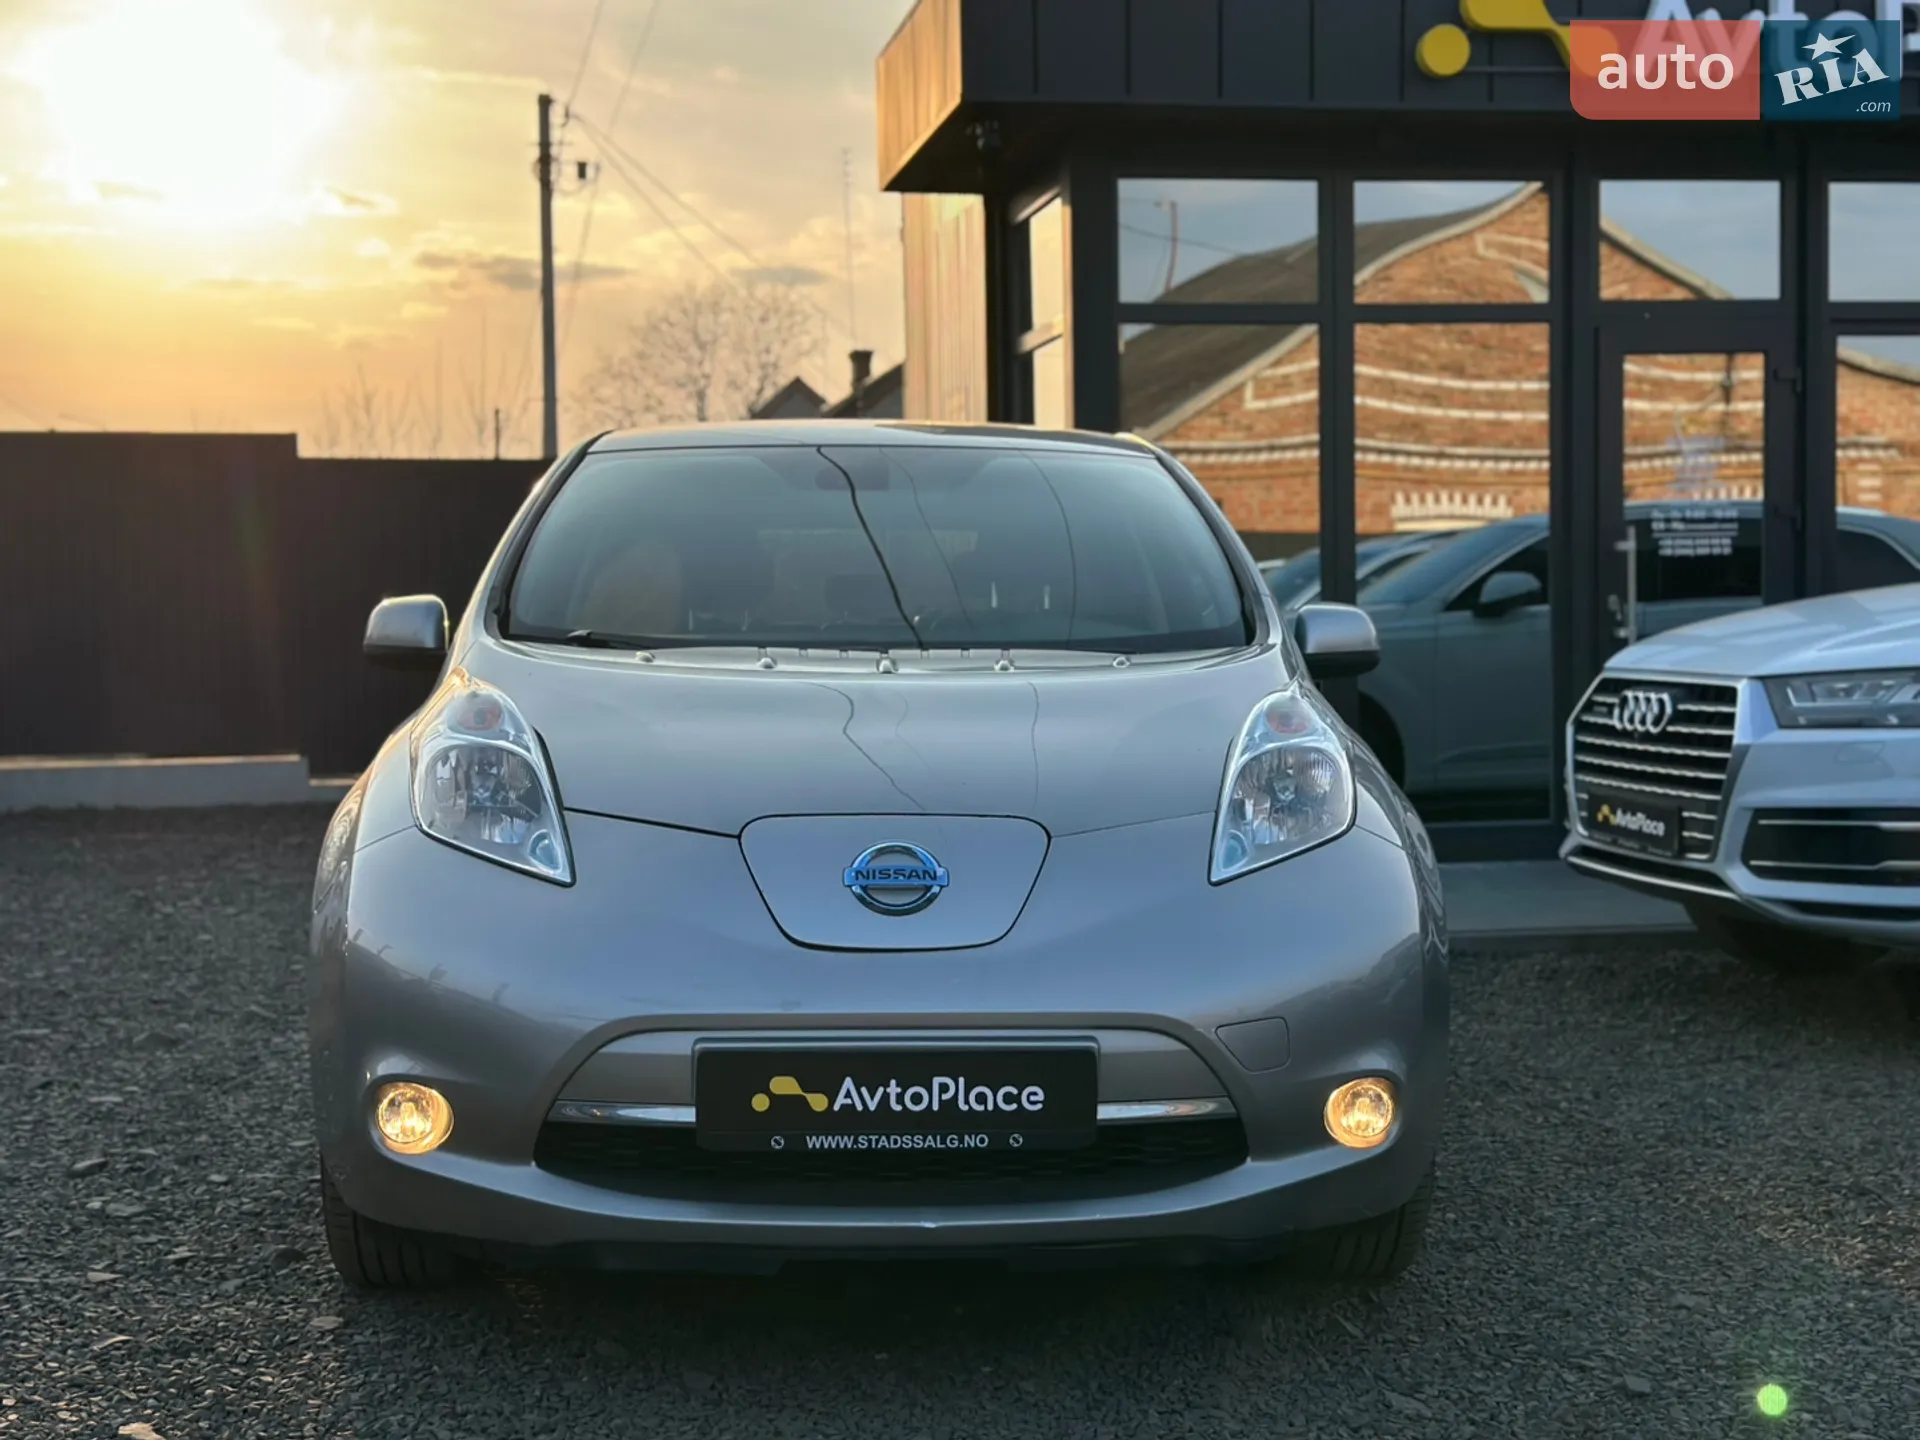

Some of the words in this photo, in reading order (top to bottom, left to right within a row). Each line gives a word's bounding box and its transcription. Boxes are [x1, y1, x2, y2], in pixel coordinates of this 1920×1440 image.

[855, 868, 938, 881] NISSAN
[833, 1076, 1045, 1112] AvtoPlace
[806, 1134, 989, 1149] WWW.STADSSALG.NO
